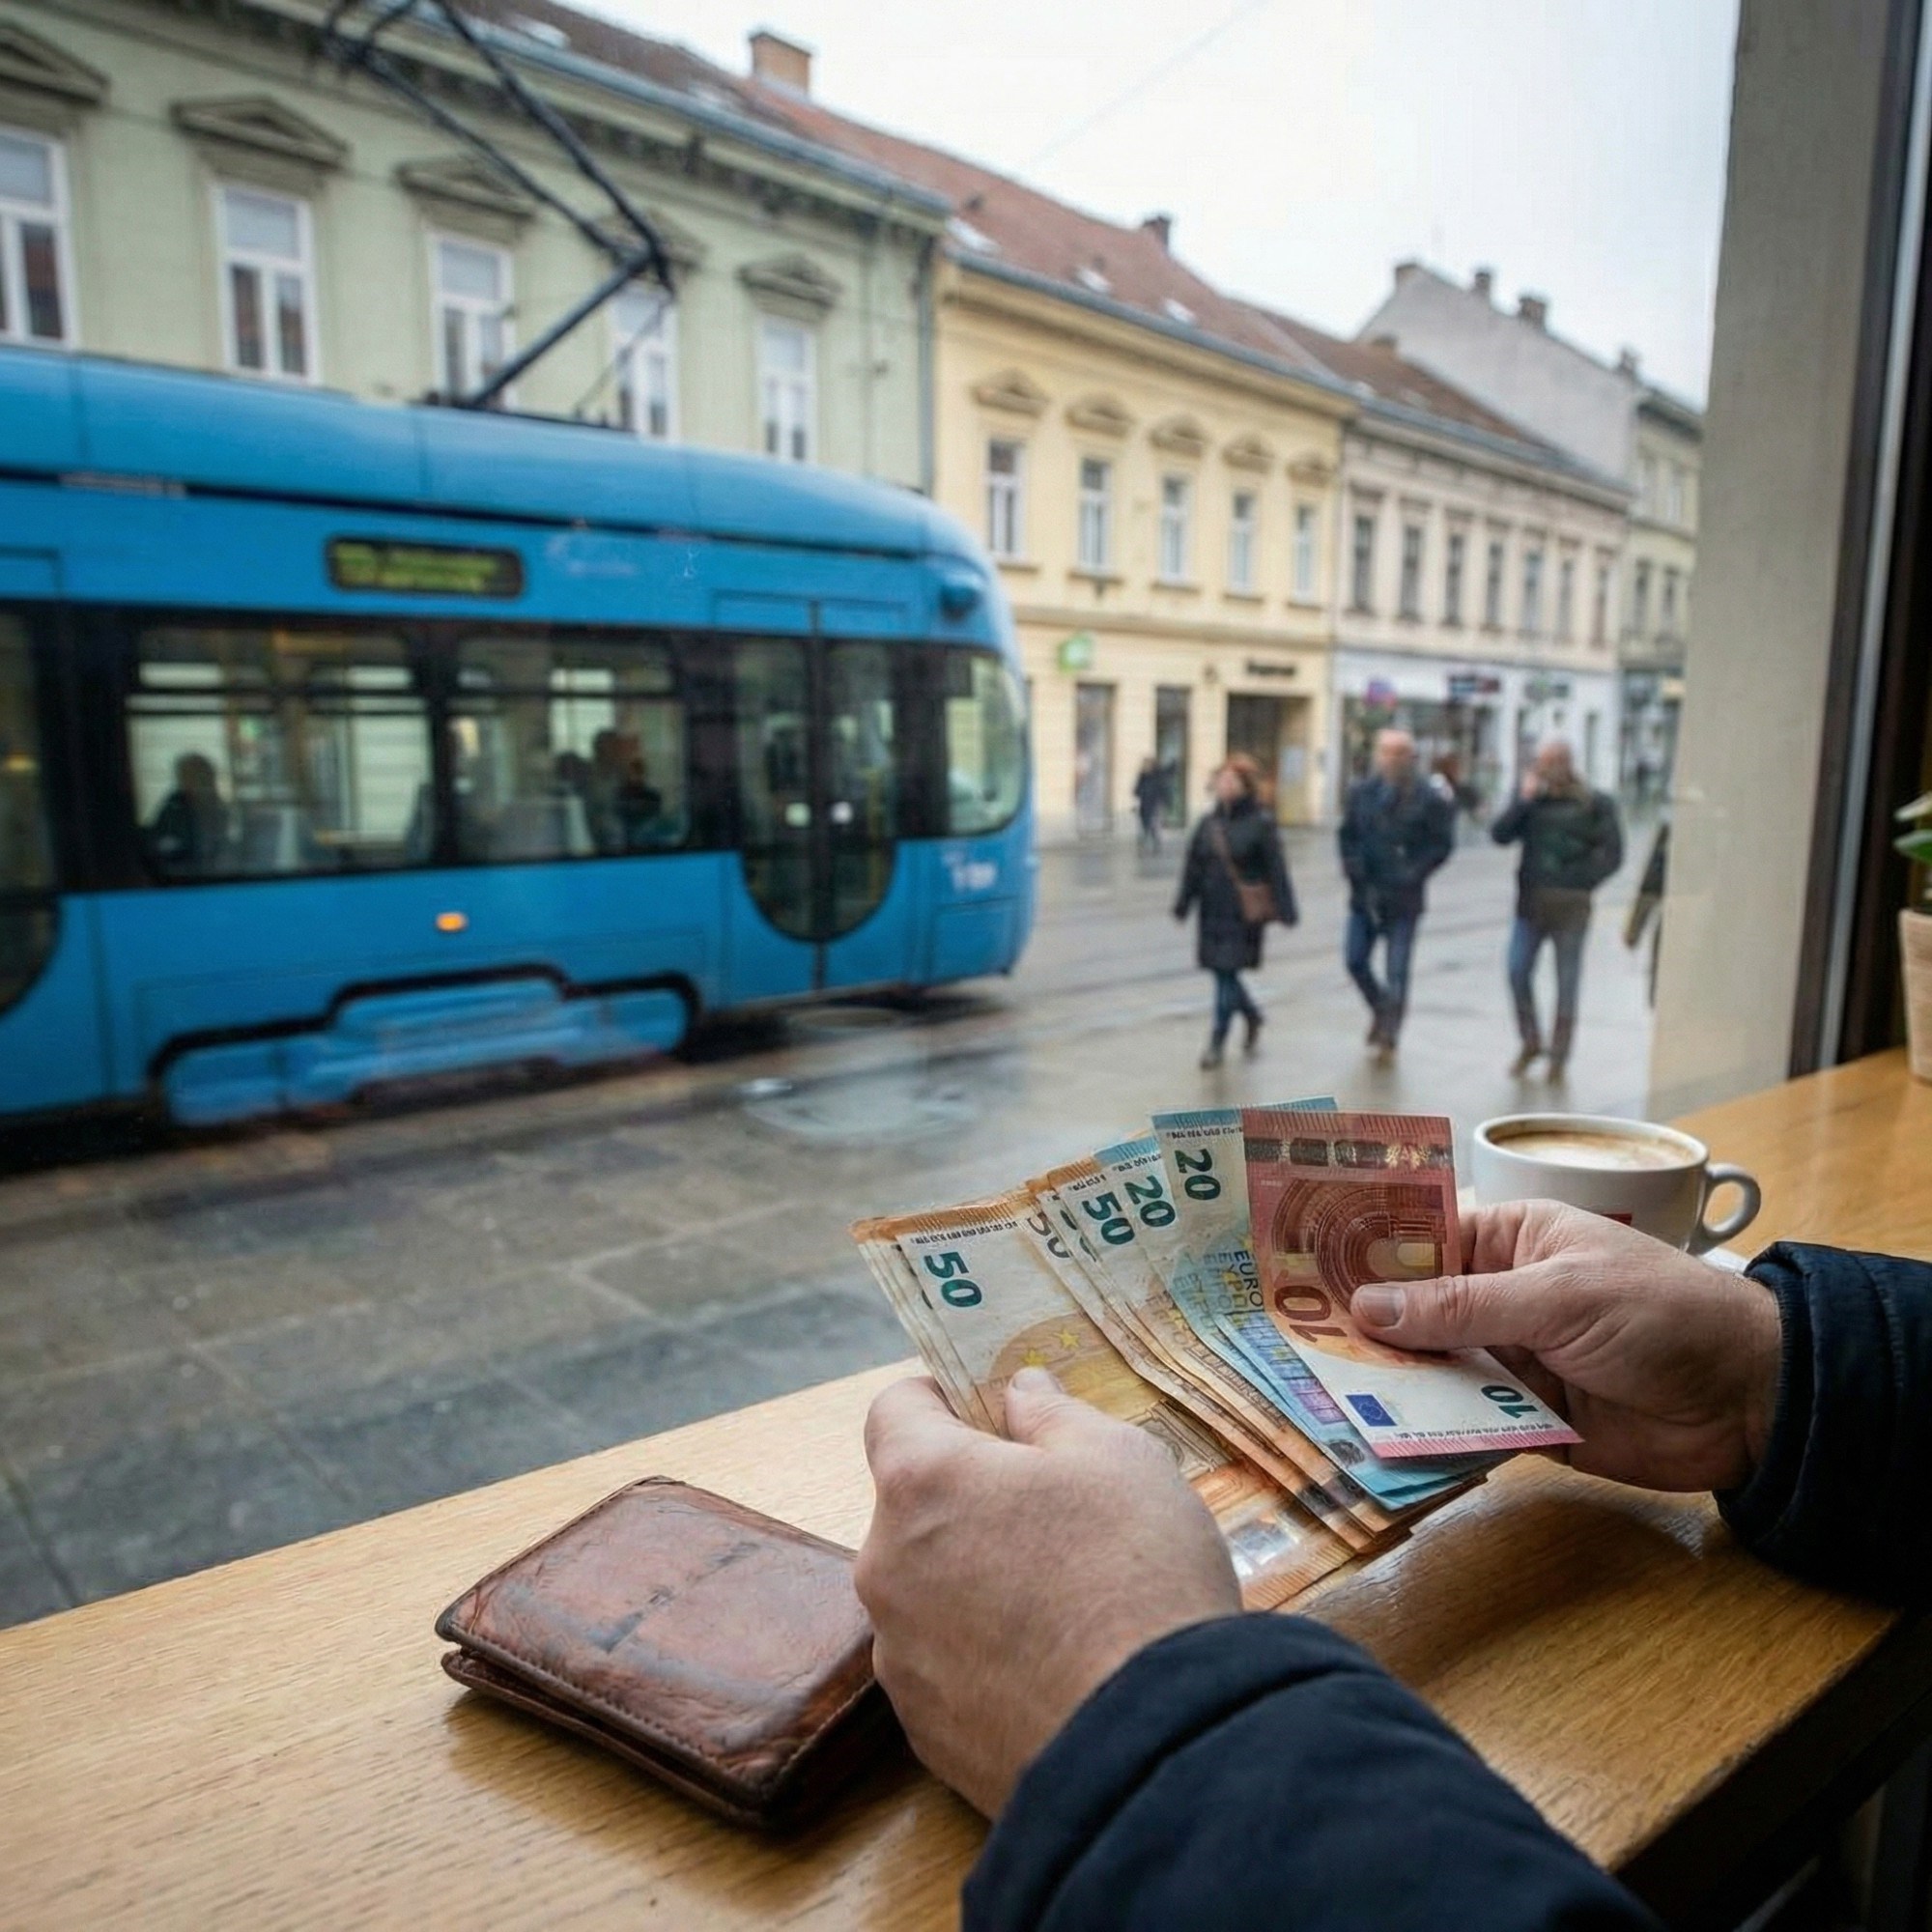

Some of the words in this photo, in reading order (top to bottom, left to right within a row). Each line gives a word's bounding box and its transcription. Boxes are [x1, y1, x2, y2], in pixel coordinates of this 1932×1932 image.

[1123, 1175, 1176, 1228] 20
[1175, 1149, 1221, 1201] 20
[1082, 1191, 1136, 1245] 50
[923, 1251, 983, 1308] 50
[1234, 1250, 1264, 1307] EURO
[1274, 1285, 1348, 1343] 10
[1480, 1384, 1539, 1419] 10
